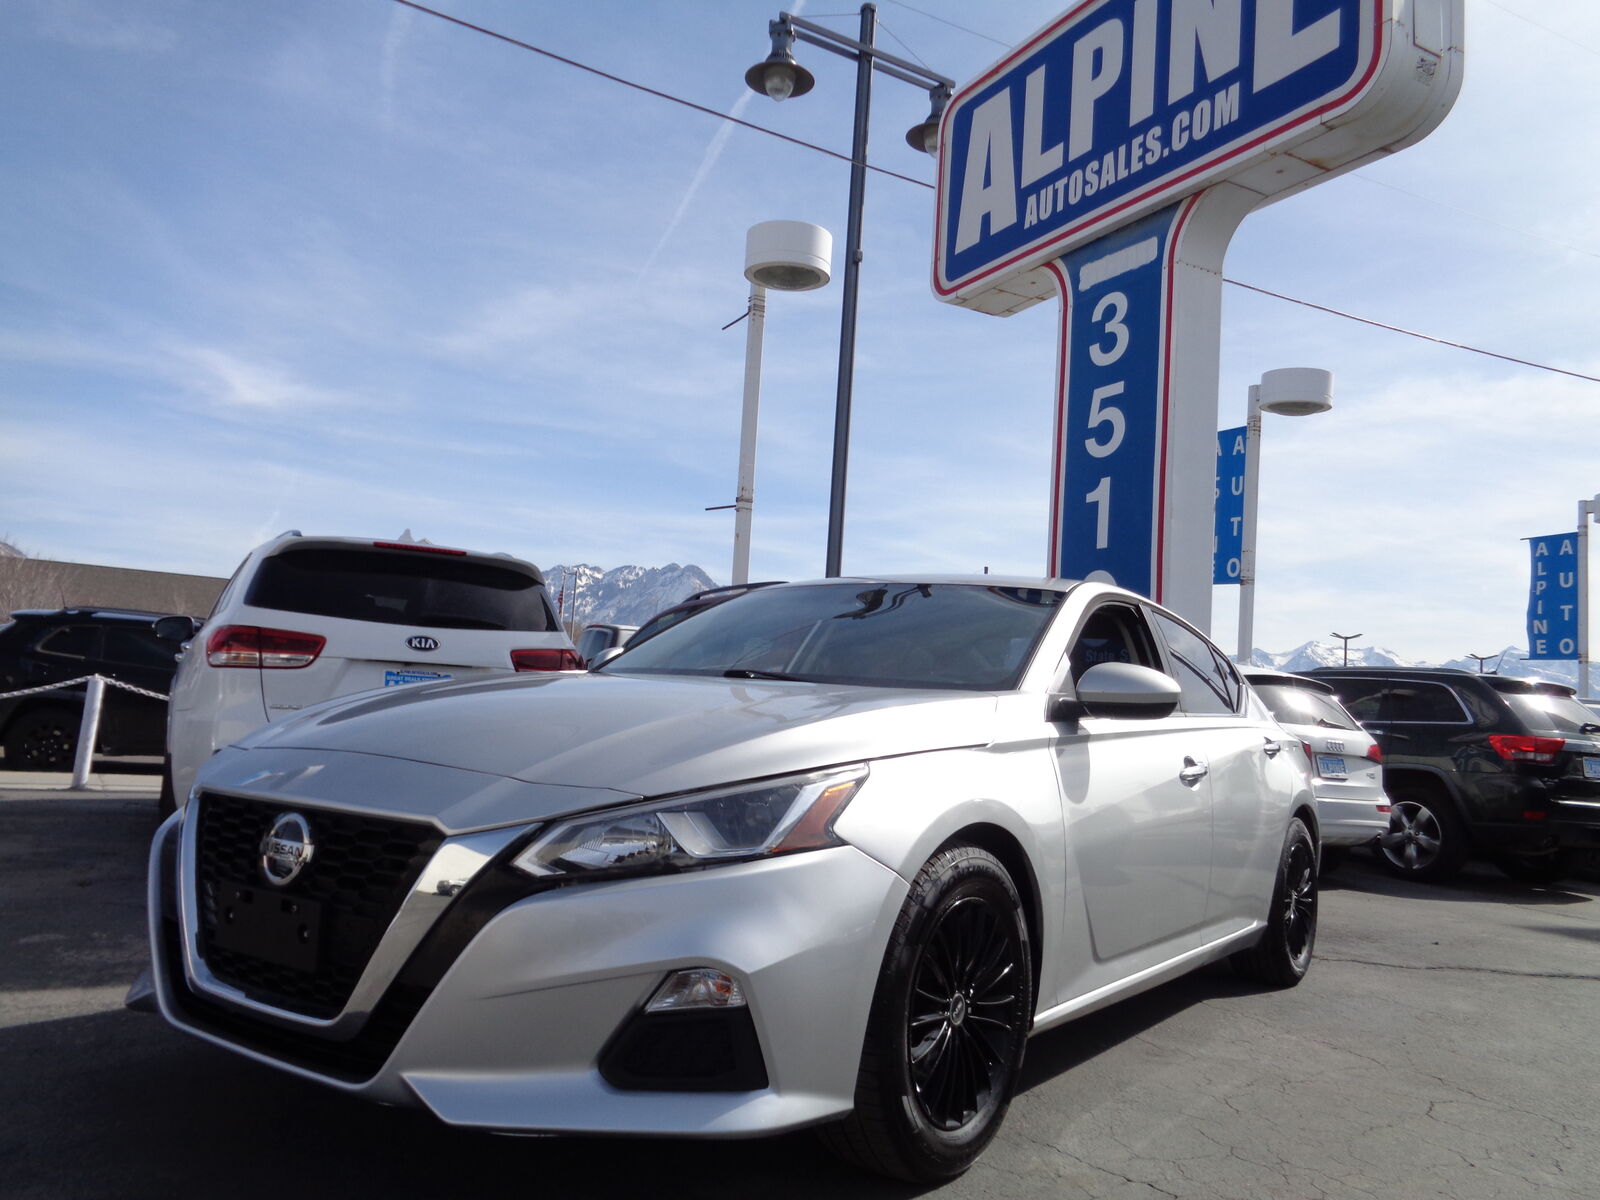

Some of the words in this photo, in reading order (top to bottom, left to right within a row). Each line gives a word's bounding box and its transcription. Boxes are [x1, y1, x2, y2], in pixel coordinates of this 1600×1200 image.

[1023, 80, 1240, 231] AUTOSALES.COM
[1084, 291, 1130, 586] 351
[1226, 434, 1246, 579] AUTO
[411, 637, 435, 649] KIA
[1532, 541, 1549, 655] ALPINE
[1558, 538, 1575, 655] AUTO
[263, 838, 304, 859] NISSAN
